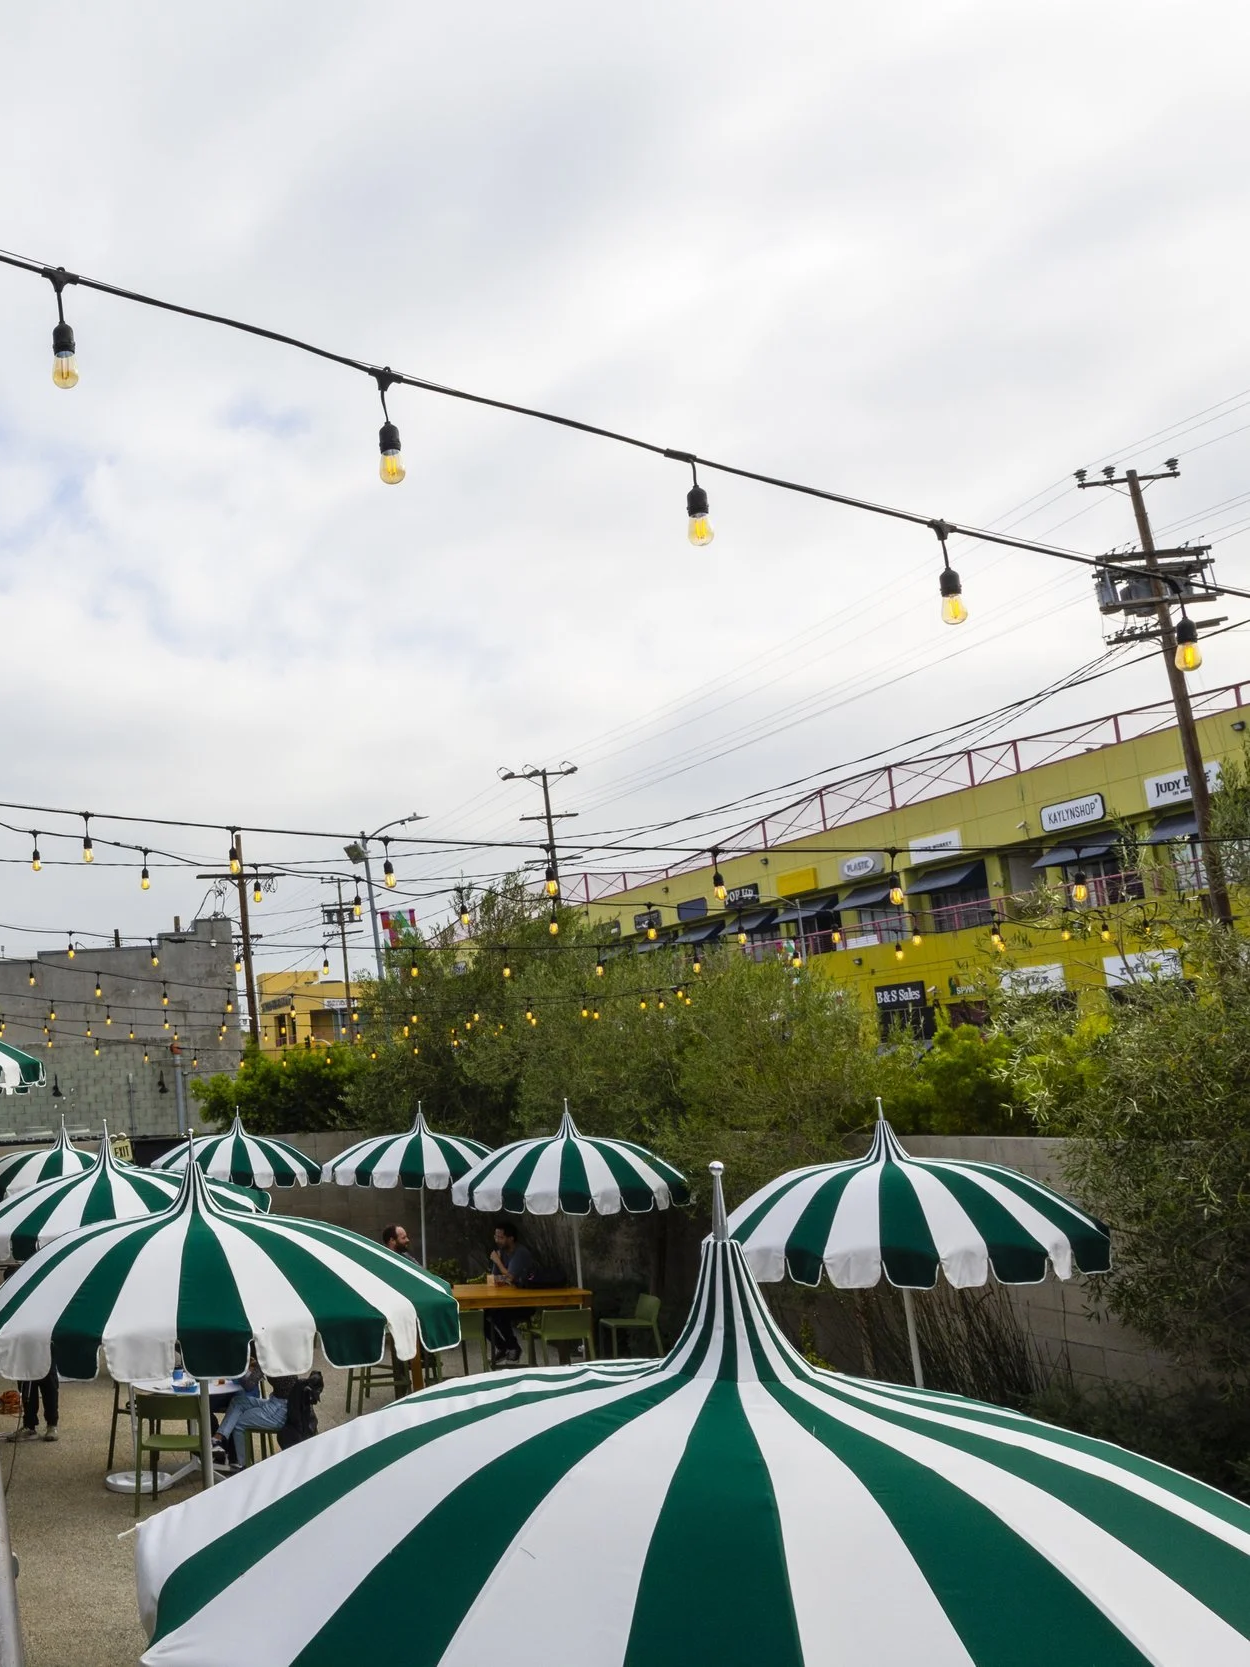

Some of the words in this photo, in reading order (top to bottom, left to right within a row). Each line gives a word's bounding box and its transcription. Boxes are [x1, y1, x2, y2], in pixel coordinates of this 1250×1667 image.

[1154, 778, 1182, 798] JUDY
[1183, 771, 1210, 788] BE
[1047, 801, 1096, 825] KAYLYNSHOP
[846, 860, 870, 873] PLASTIC
[898, 987, 921, 1002] Sales
[114, 1145, 130, 1157] EXIT
